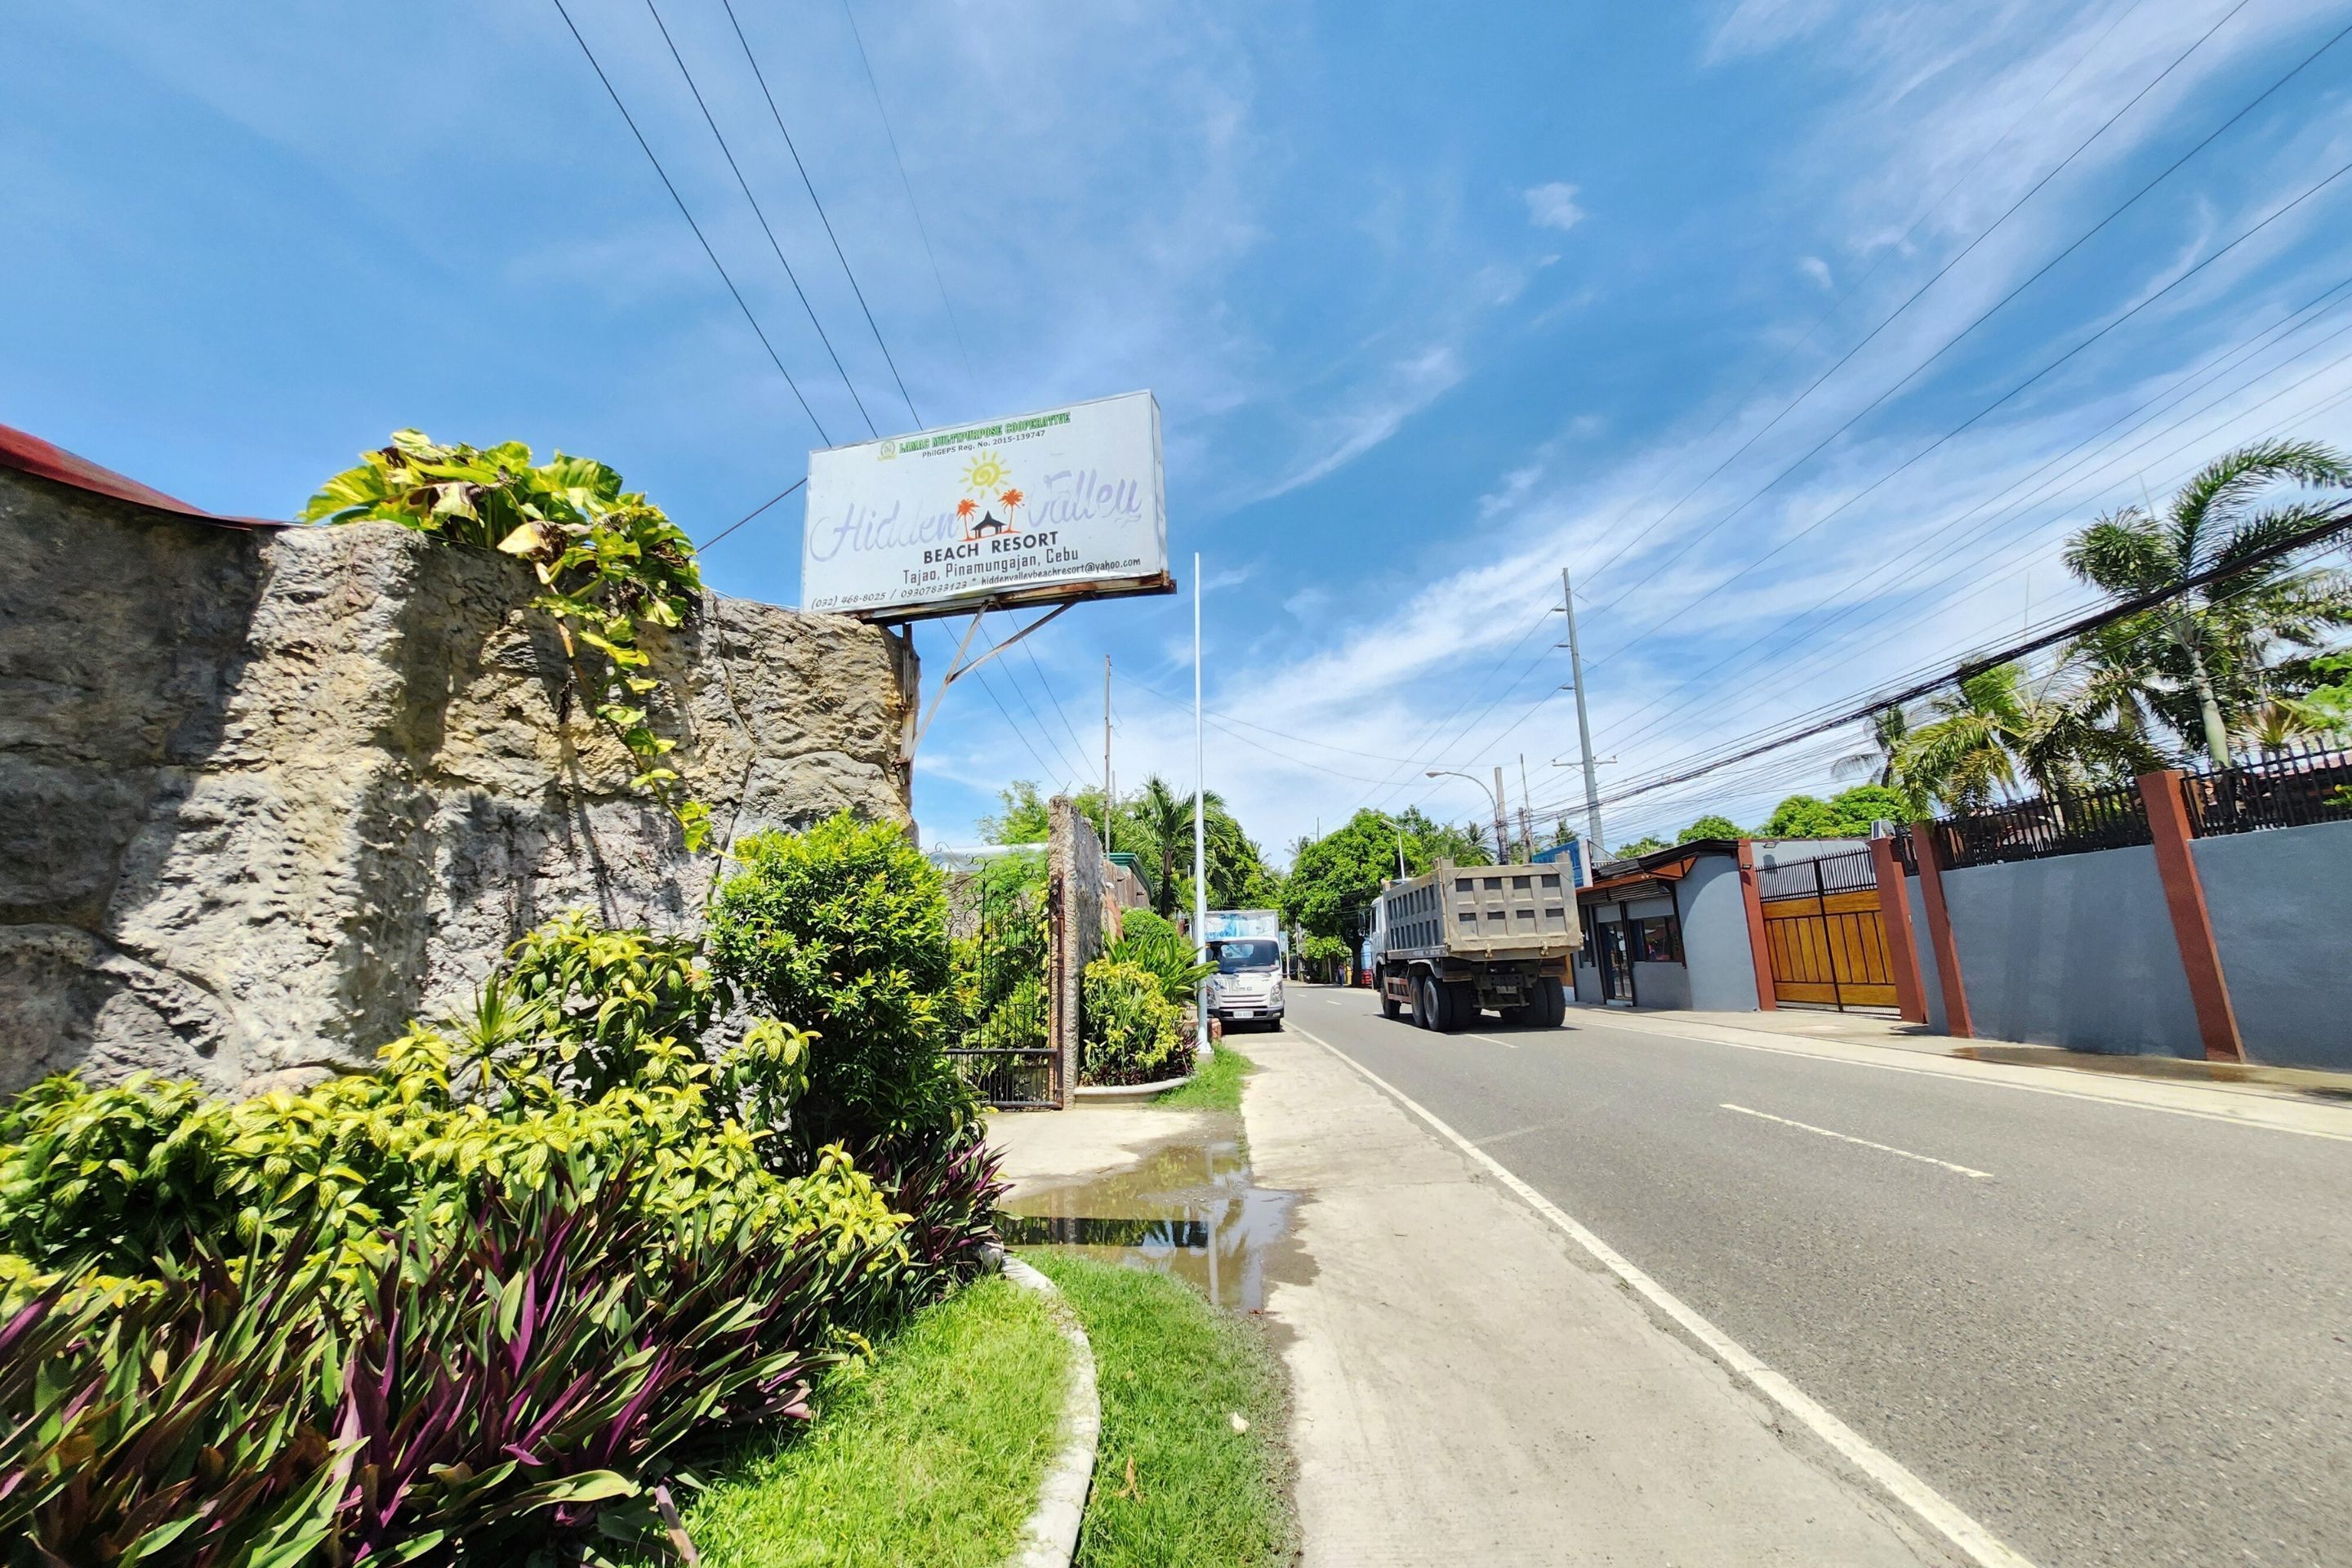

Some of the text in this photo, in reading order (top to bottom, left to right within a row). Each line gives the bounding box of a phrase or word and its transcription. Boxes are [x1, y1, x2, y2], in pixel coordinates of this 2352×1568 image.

[899, 412, 1071, 454] LAMAC MULTIPURPOSE COOPERATIVE
[922, 430, 1045, 458] PhilGEPS Reg. No. 2015-139747
[903, 546, 1079, 586] Tajao, Pinamungajan, Cebu
[924, 531, 1058, 564] BEACH RESORT
[811, 595, 838, 610] (032)
[841, 591, 886, 604] 468-8025
[901, 581, 968, 598] 09307833123
[982, 558, 1141, 586] hiddenvalleybeachresort@yahoo.com
